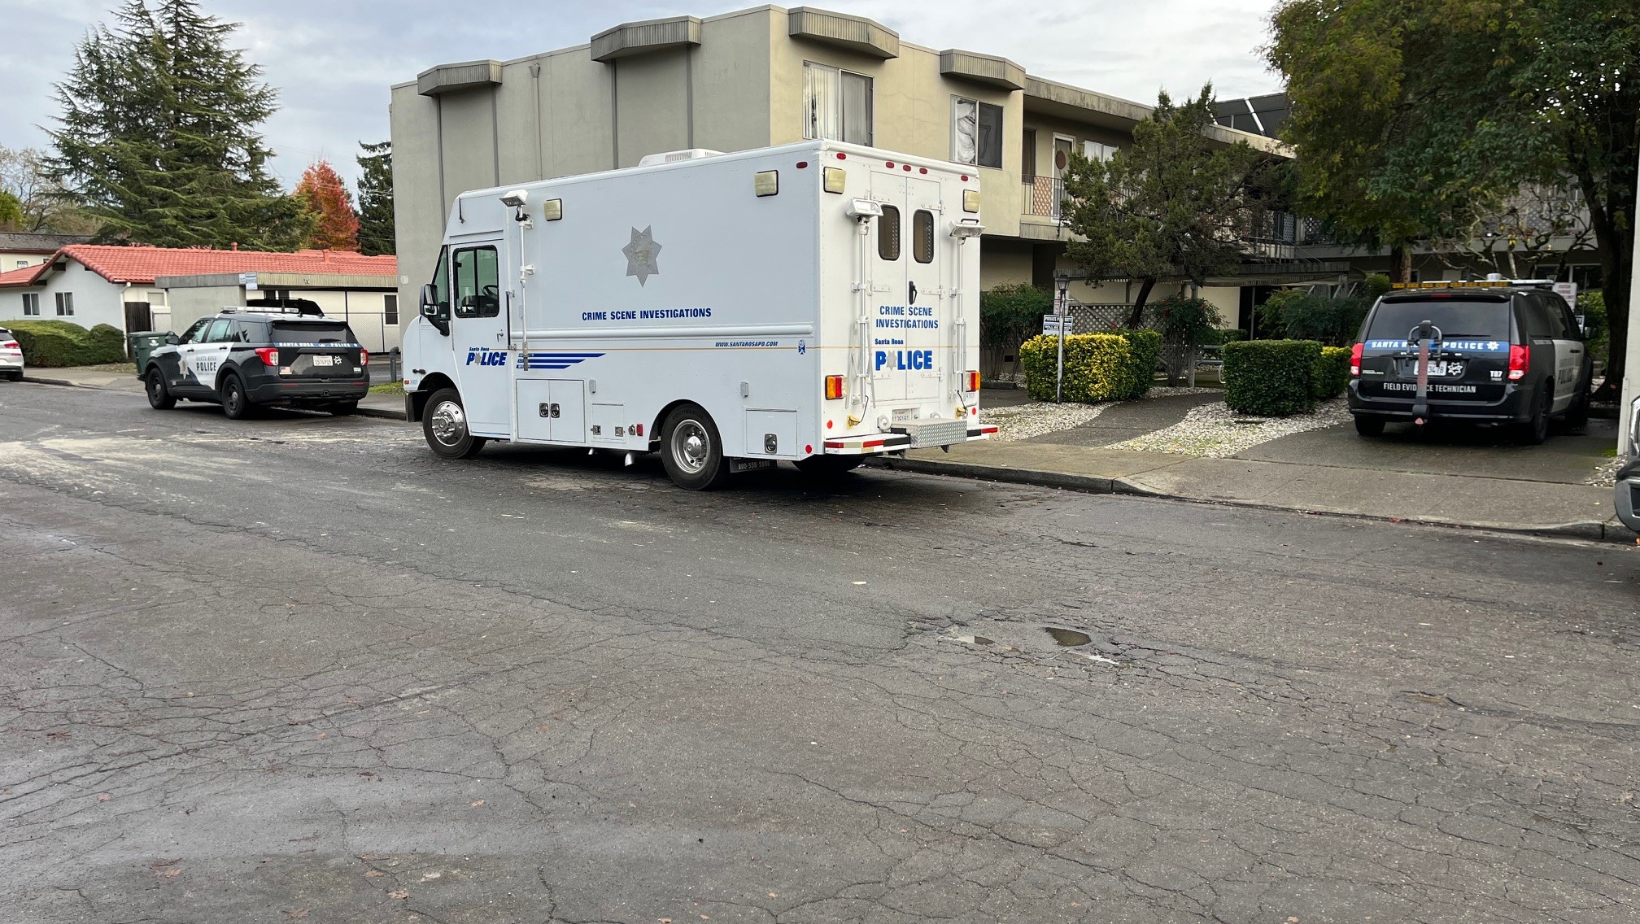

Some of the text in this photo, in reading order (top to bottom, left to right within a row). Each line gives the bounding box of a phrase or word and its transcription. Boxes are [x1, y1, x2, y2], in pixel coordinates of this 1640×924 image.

[582, 308, 712, 321] CRIME SCENE INVESTIGATIONS
[879, 305, 933, 316] CRIME SCENE
[875, 318, 939, 329] INVESTIGATIONS
[1442, 341, 1484, 350] POLICE
[466, 351, 508, 366] PLICE
[875, 350, 933, 371] PLICE
[196, 361, 217, 372] POLICE
[1383, 382, 1477, 393] FIELD EVIDCE TECHNICIAN
